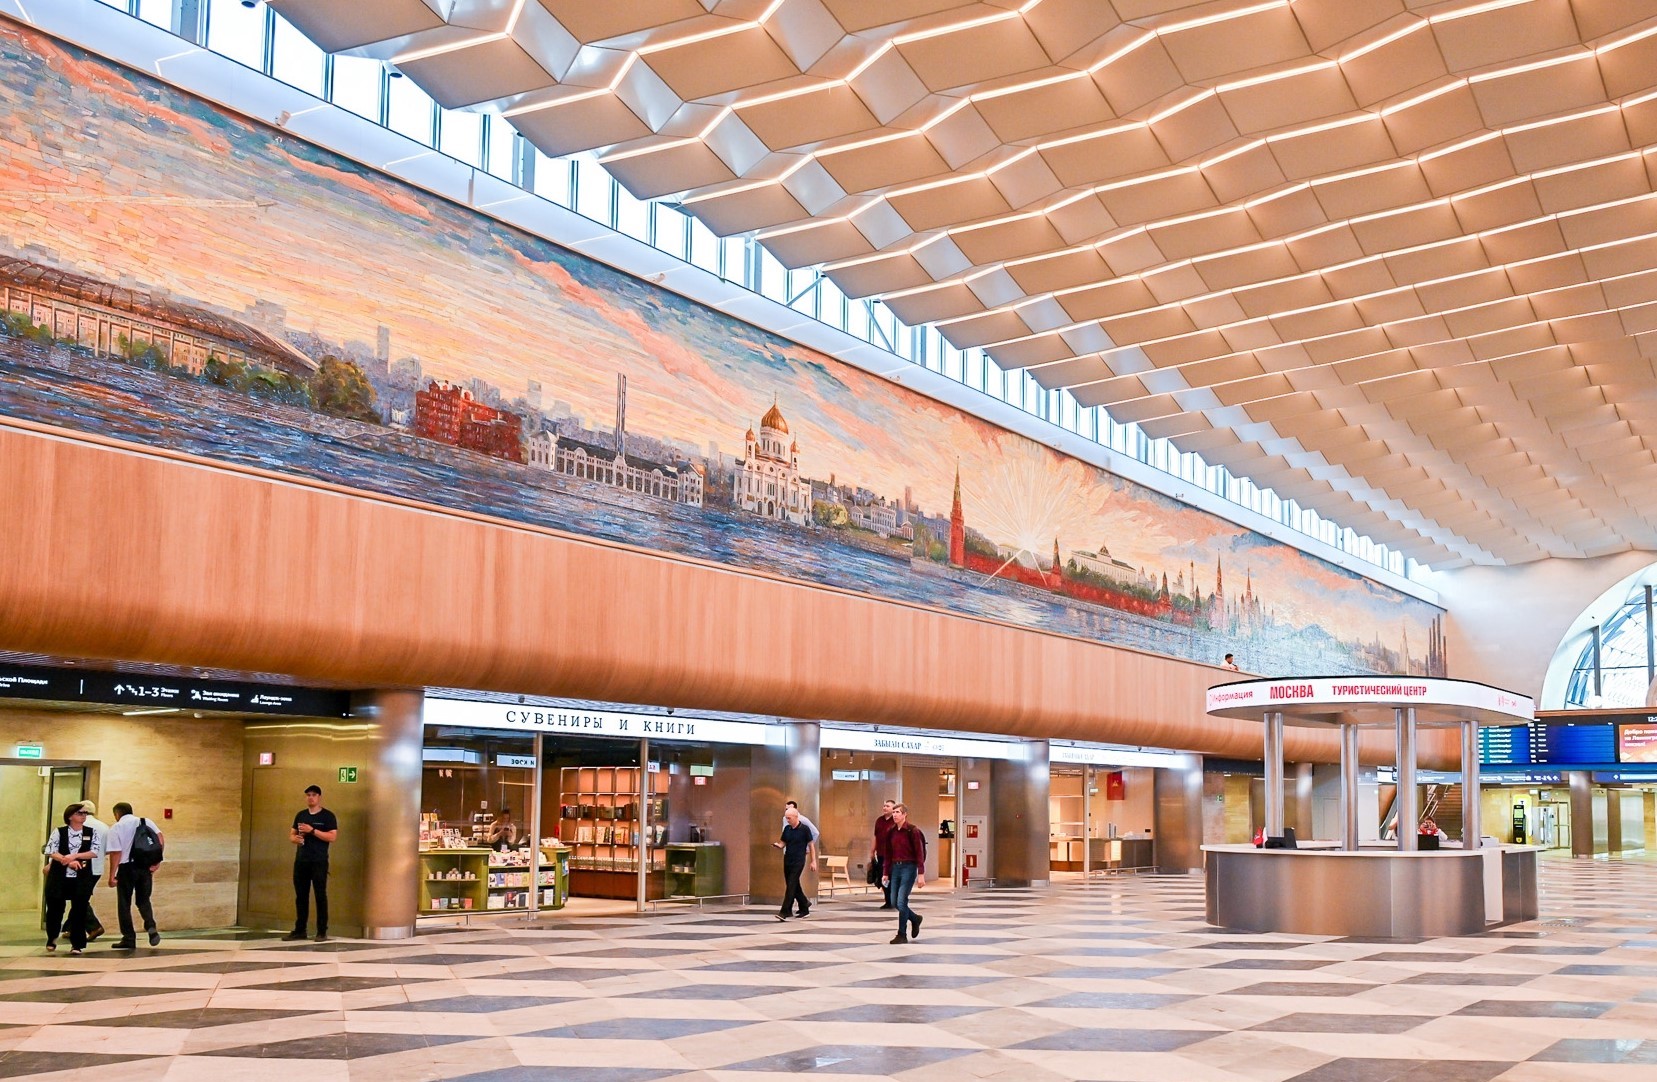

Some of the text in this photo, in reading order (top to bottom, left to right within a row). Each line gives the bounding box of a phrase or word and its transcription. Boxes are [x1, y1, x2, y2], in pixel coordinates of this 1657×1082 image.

[1270, 685, 1314, 699] МОСКВА
[1331, 684, 1427, 697] ТУРИСТИЧЕСКИЙ ЦЕНТР
[506, 710, 695, 735] СУВЕНИРЫ И КНИГИ
